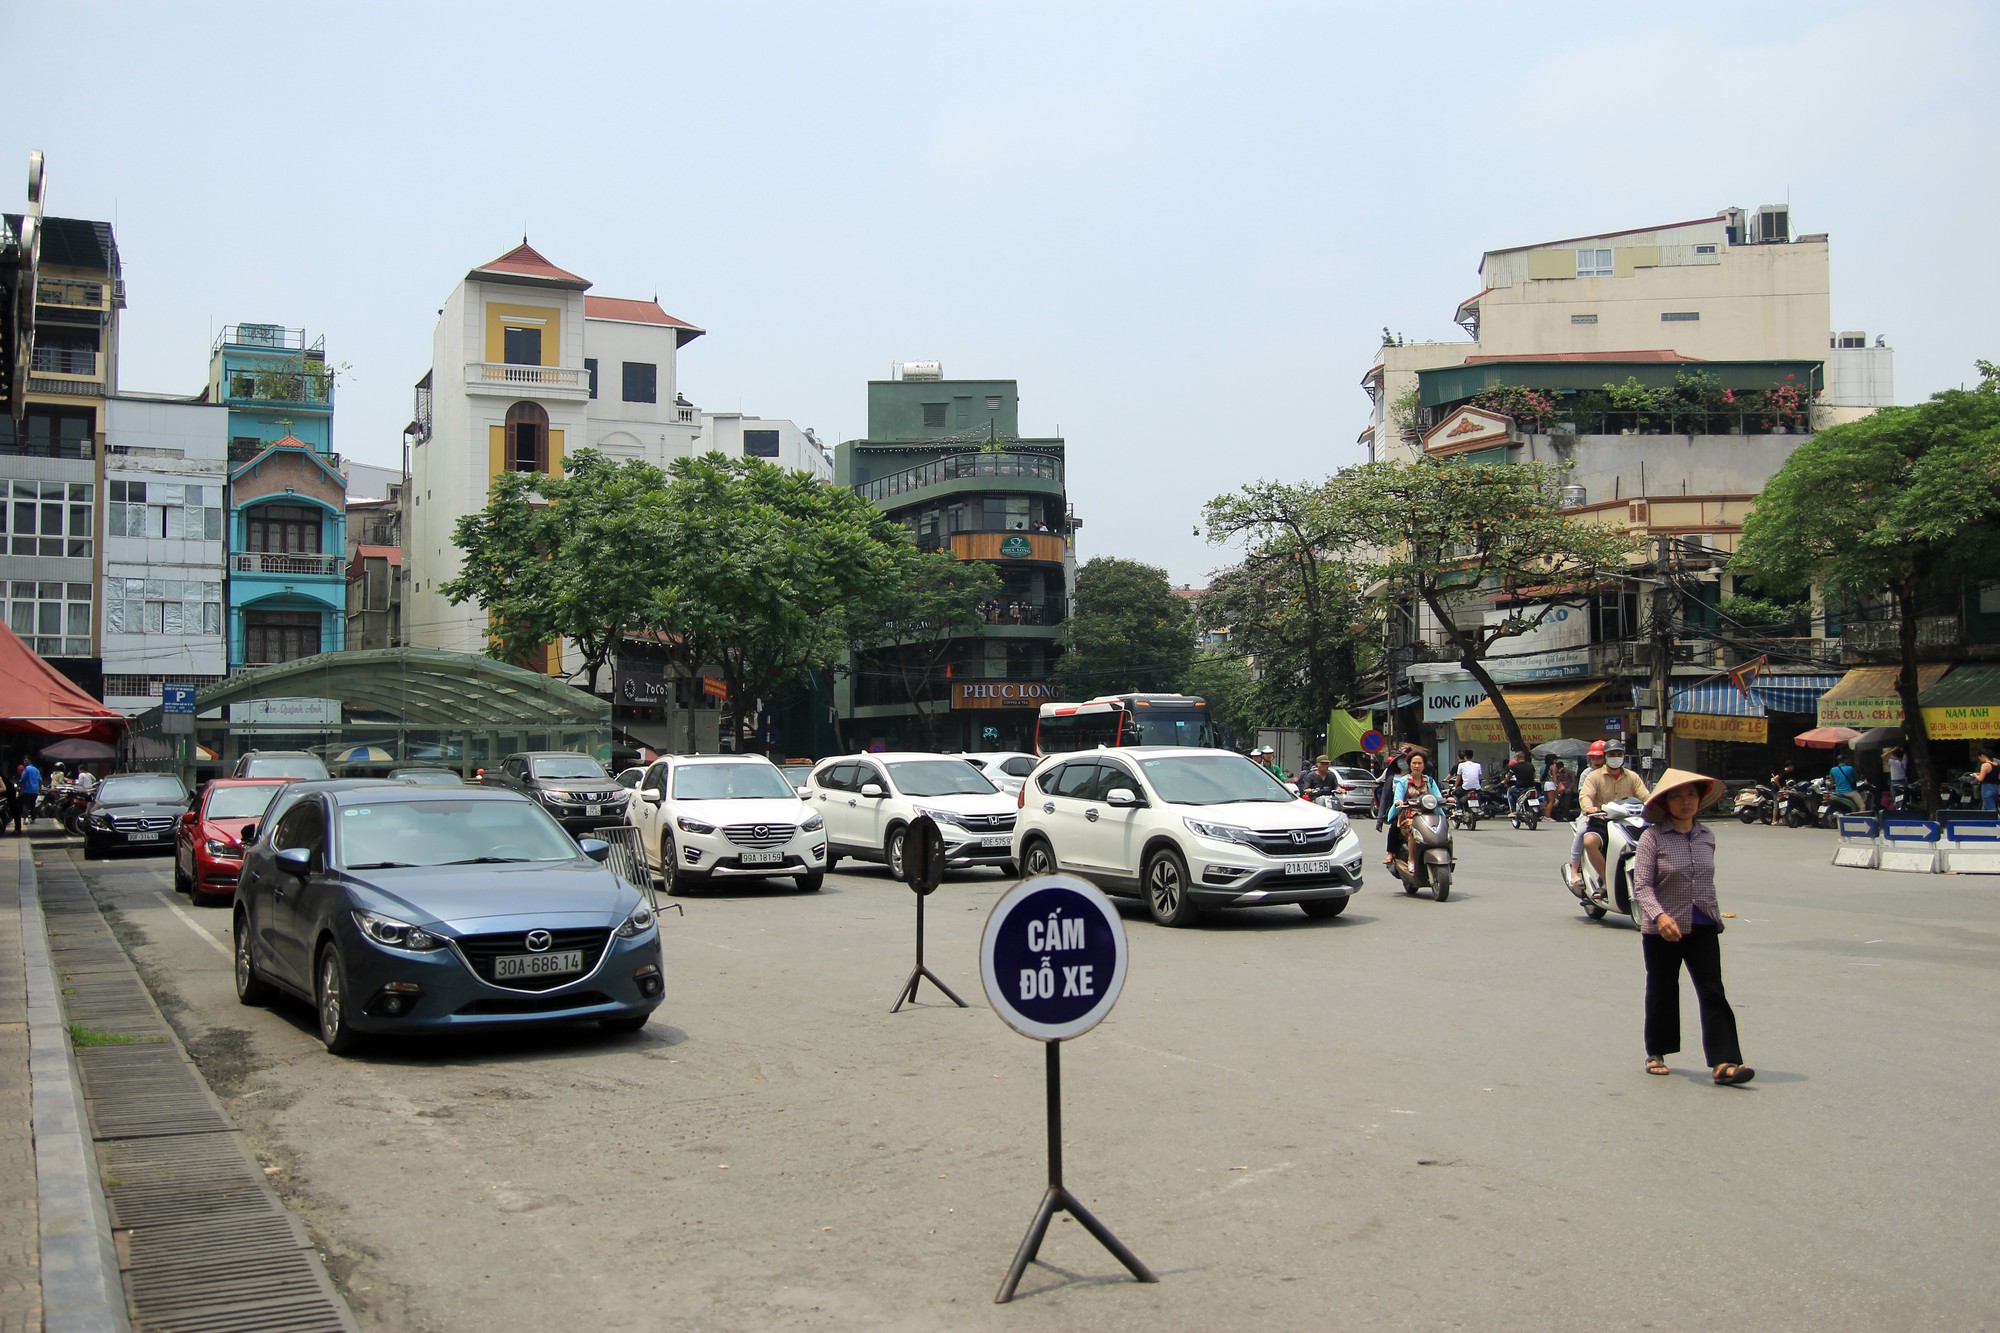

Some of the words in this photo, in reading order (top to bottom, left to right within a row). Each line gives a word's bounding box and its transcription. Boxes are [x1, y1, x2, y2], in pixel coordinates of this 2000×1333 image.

[176, 691, 186, 702] P
[963, 684, 1014, 698] PHUC
[1019, 684, 1059, 698] LONG
[1428, 695, 1460, 709] LONG
[1821, 706, 1841, 720] CHẢ
[1843, 710, 1865, 720] CUA
[1872, 706, 1893, 720] CHẢ
[1945, 708, 1967, 718] NAM
[1969, 707, 1989, 717] ANH
[1692, 716, 1716, 730] CHẢ
[1028, 907, 1085, 952] CẤM
[498, 953, 579, 976] 30A-686.14
[1020, 956, 1055, 1000] ĐỖ
[1062, 965, 1094, 997] XE
